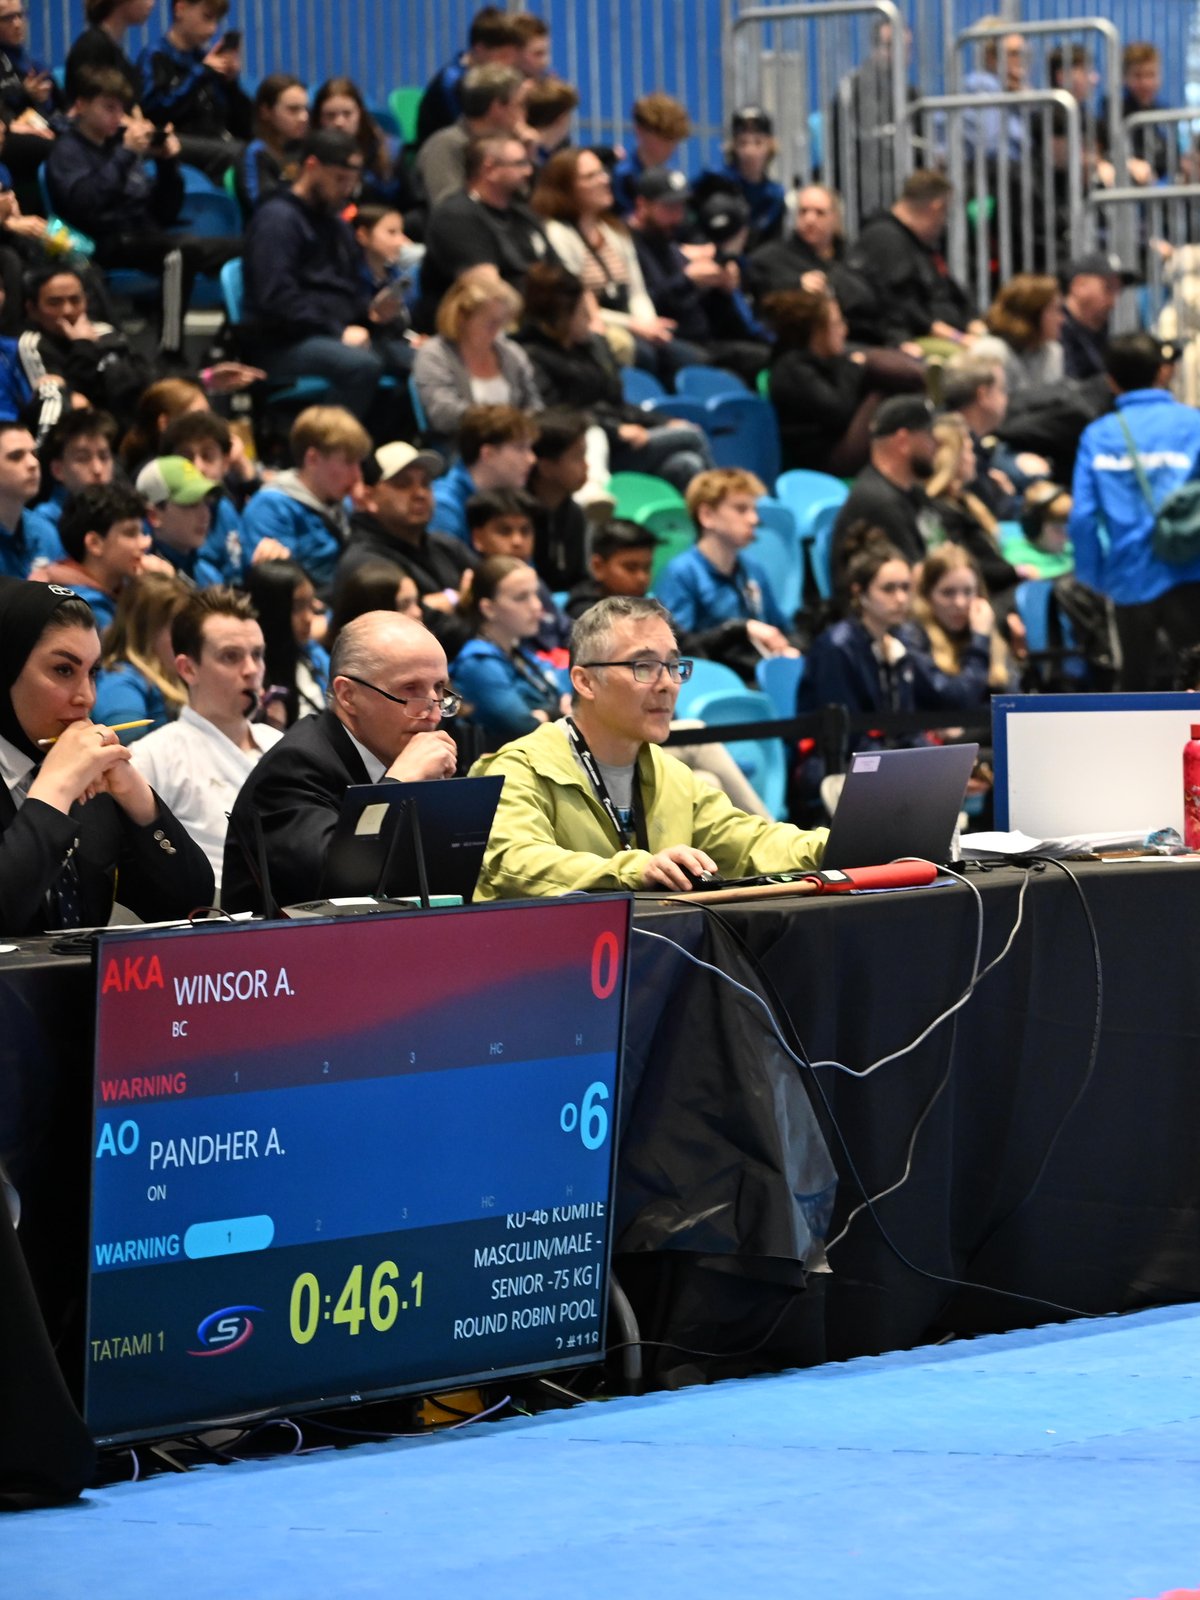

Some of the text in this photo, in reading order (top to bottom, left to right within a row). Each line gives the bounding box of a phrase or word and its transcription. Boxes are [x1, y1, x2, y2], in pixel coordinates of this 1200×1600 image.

[102, 955, 165, 994] AKA
[591, 931, 619, 999] 0
[174, 967, 295, 1006] WINSOR A.
[172, 1020, 188, 1037] BC
[101, 1033, 582, 1101] WARNING 1 2 3 HC H
[95, 1119, 139, 1158] AO
[150, 1127, 285, 1170] PANDHER A.
[147, 1184, 167, 1201] ON
[95, 1234, 180, 1266] WARNING
[227, 1231, 232, 1243] 1
[402, 1208, 408, 1220] 3
[474, 1232, 593, 1268] MASCULIN/MALE
[491, 1273, 544, 1300] SENIOR
[547, 1269, 569, 1290] -75
[573, 1265, 593, 1287] KG
[290, 1260, 423, 1345] 0:46.1
[454, 1299, 598, 1339] ROUND ROBIN POOL
[91, 1330, 165, 1362] TATAMI 1
